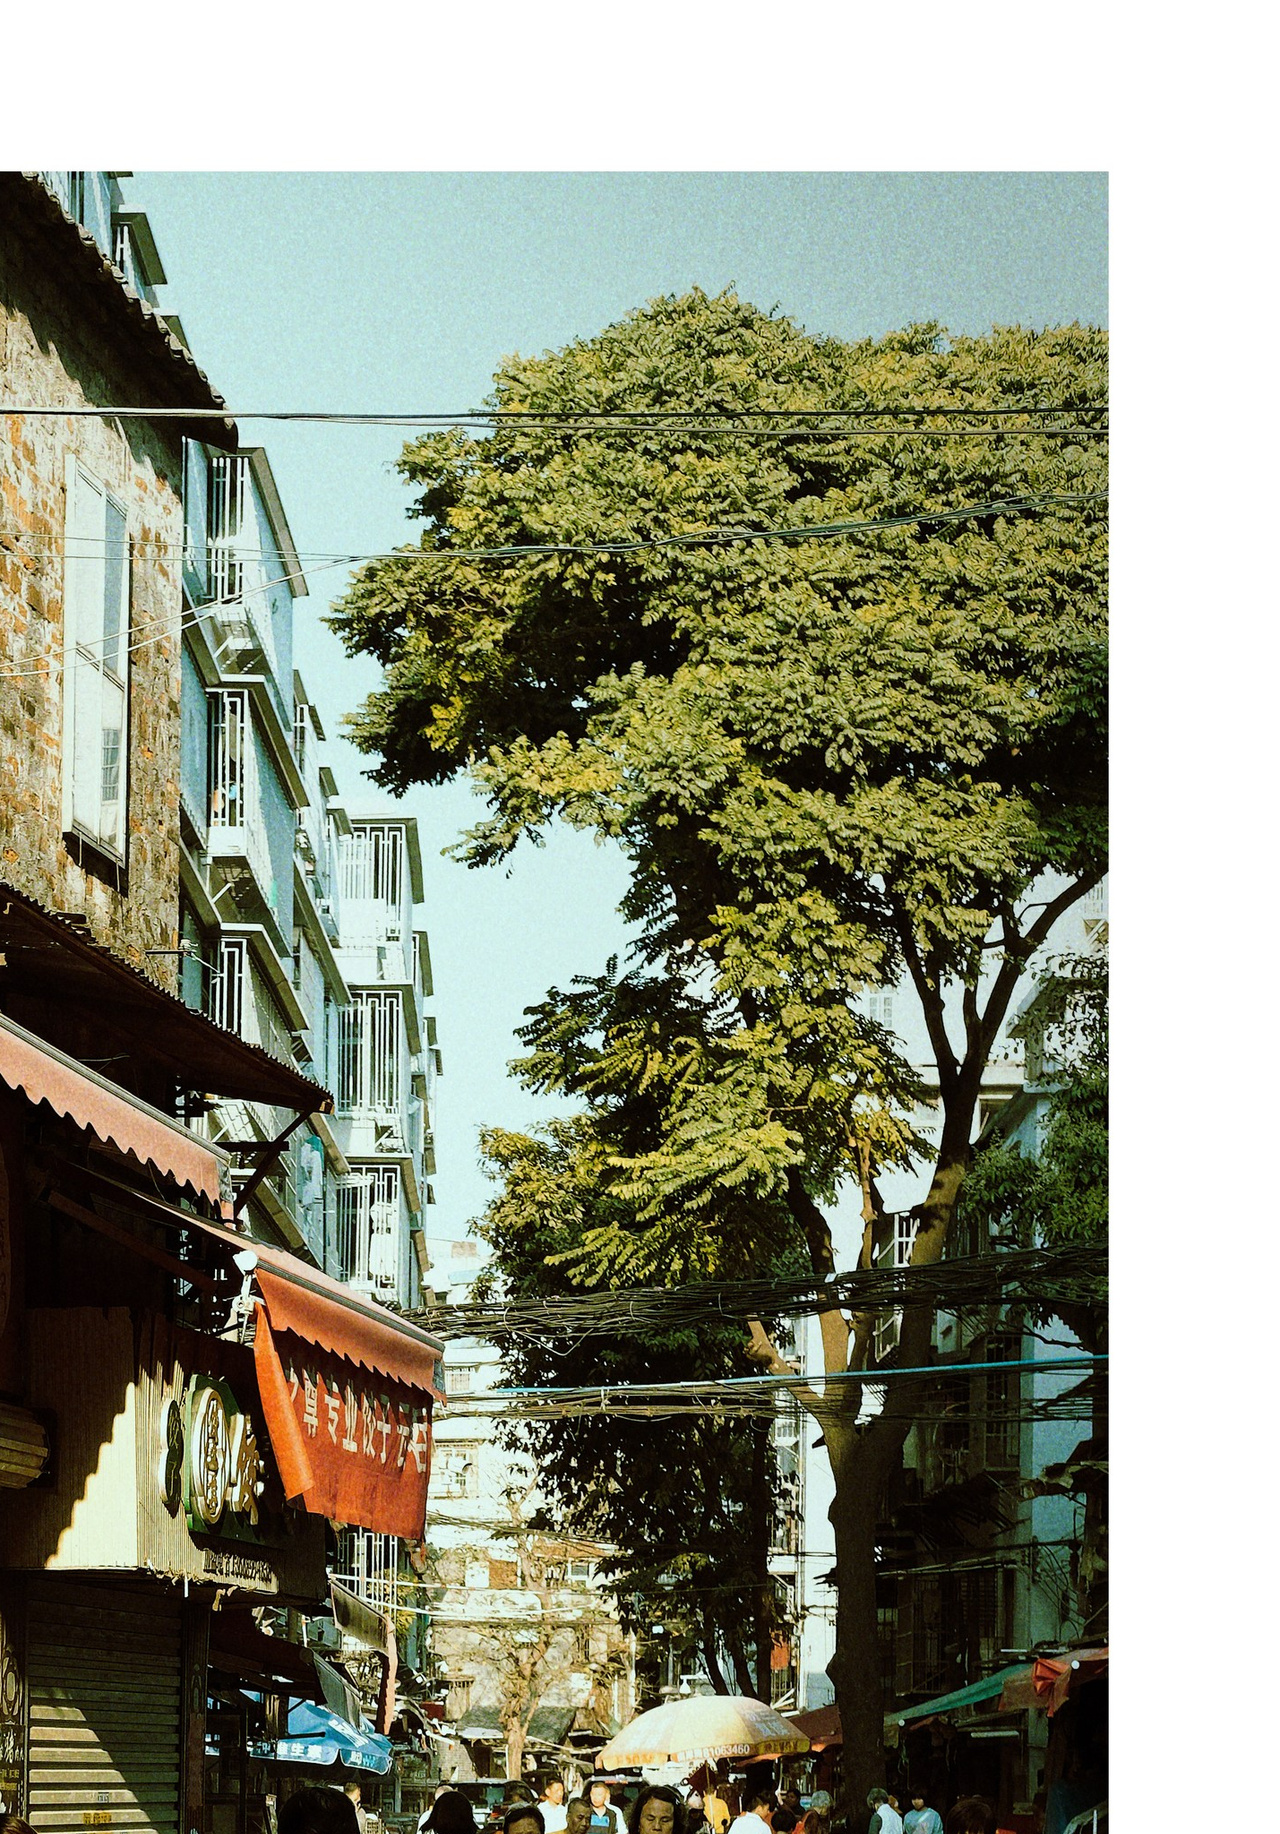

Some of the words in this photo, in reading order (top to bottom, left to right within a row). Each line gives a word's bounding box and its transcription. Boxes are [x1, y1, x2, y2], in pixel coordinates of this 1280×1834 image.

[285, 1357, 428, 1474] 尊专业饺子云吞
